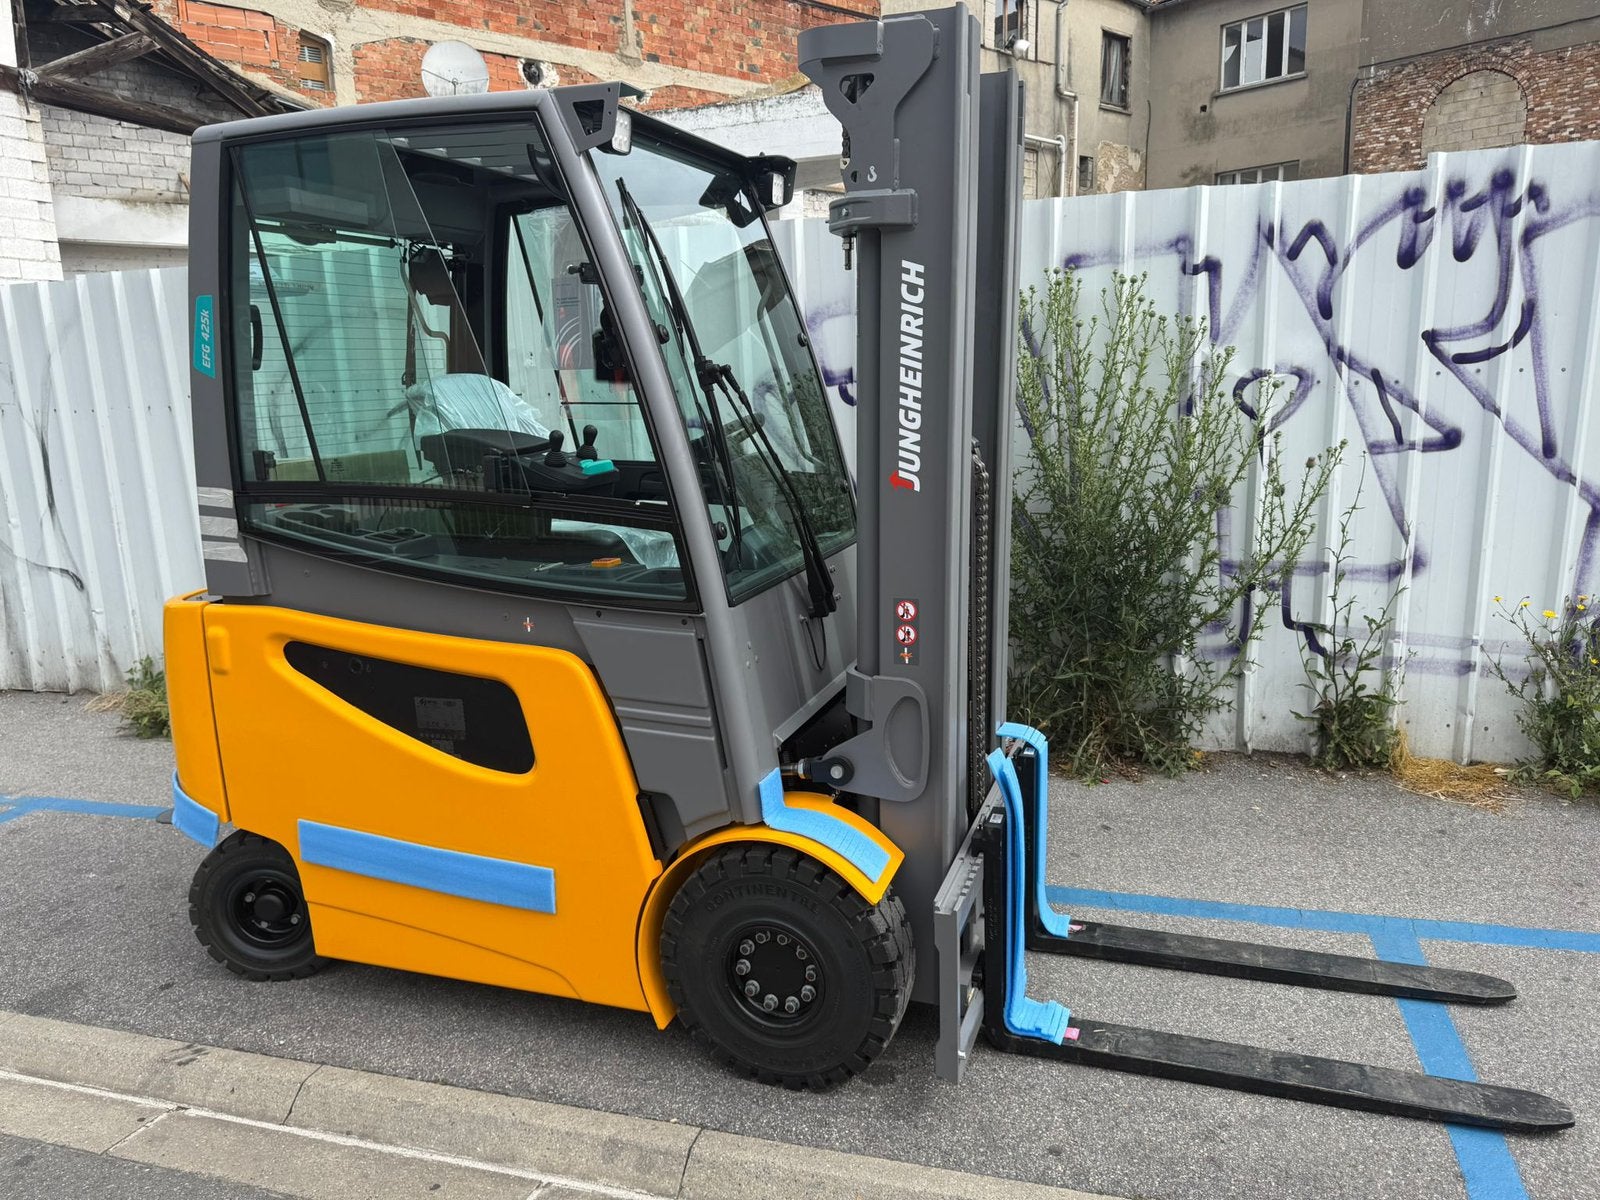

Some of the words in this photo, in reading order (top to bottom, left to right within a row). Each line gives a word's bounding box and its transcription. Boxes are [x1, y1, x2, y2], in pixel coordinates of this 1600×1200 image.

[200, 309, 210, 341] 425k
[201, 343, 211, 369] EFG
[890, 259, 925, 493] JUNGHEINRICH
